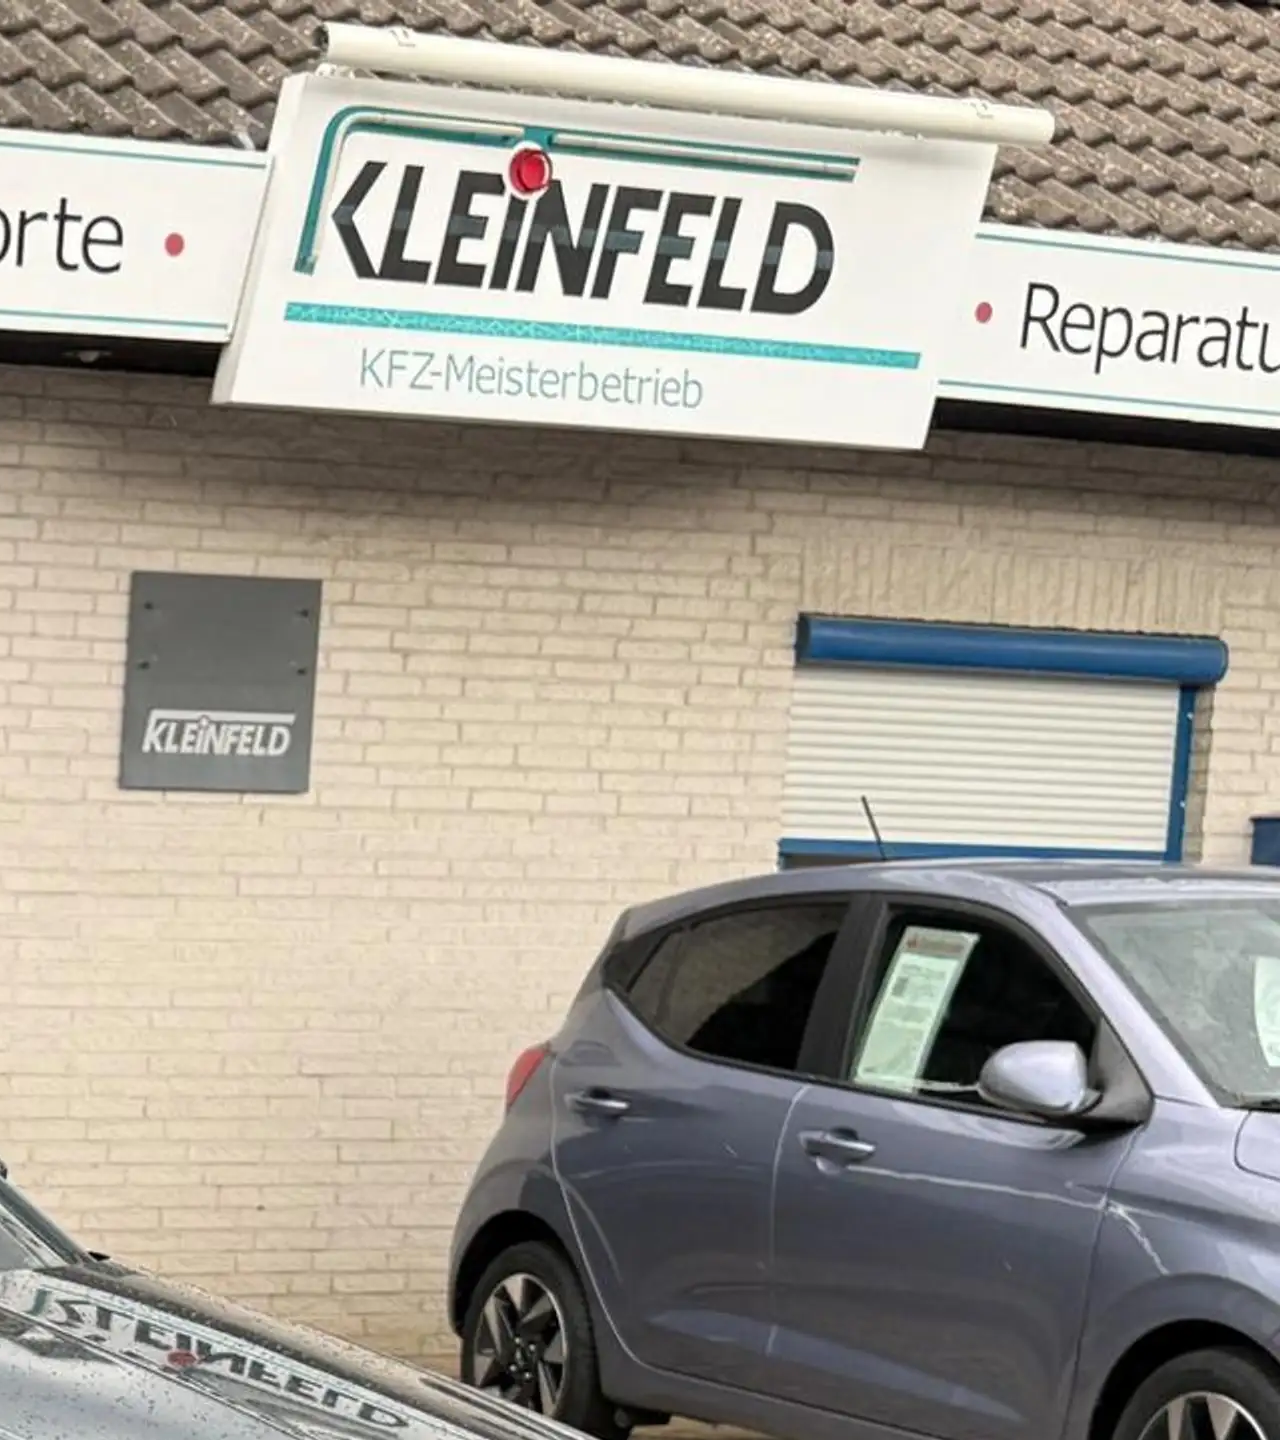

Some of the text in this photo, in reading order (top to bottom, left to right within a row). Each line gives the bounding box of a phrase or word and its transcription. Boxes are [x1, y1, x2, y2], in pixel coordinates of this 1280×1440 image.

[331, 158, 835, 316] KLEINFELD
[358, 347, 704, 409] KFZ-Meisterbetrieb
[141, 720, 292, 757] KLEINFELD
